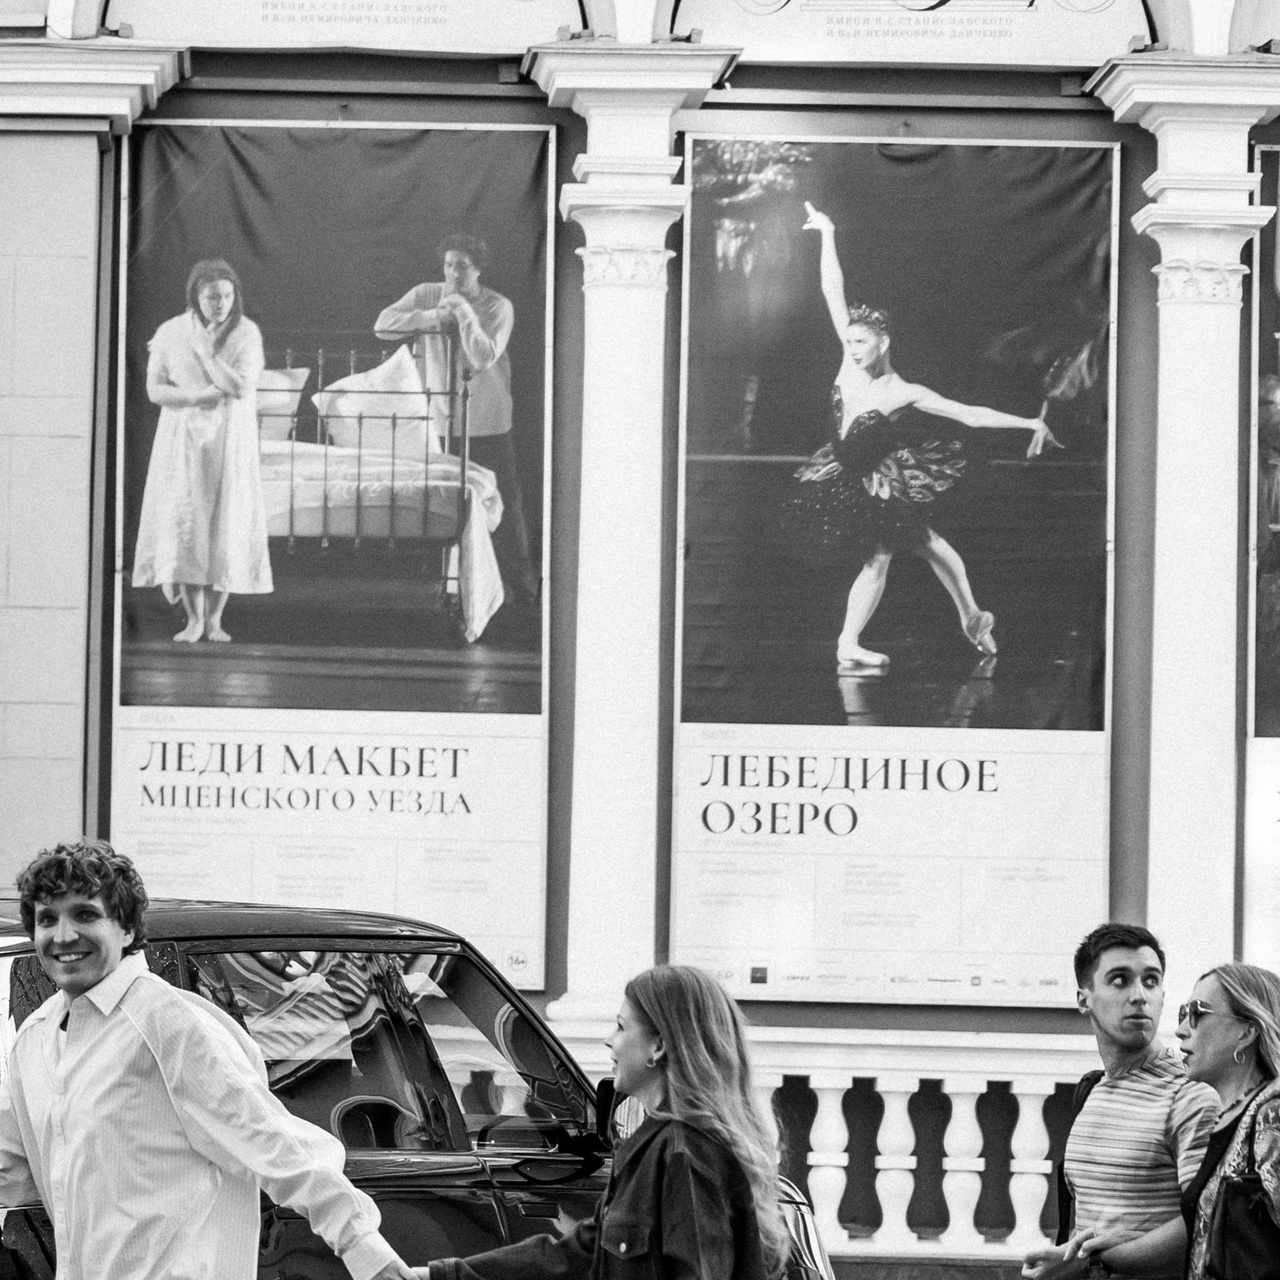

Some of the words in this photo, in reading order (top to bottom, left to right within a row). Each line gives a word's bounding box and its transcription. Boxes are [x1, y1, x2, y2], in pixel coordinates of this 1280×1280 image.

[140, 740, 265, 778] ЛЕДИ
[281, 743, 470, 779] МАКБЕТ
[699, 753, 1000, 796] ЛЕБЕДИНОЕ
[140, 784, 356, 811] МЦЕНСКОГО
[367, 788, 473, 815] УЕЗДА
[700, 800, 859, 837] ОЗЕРО
